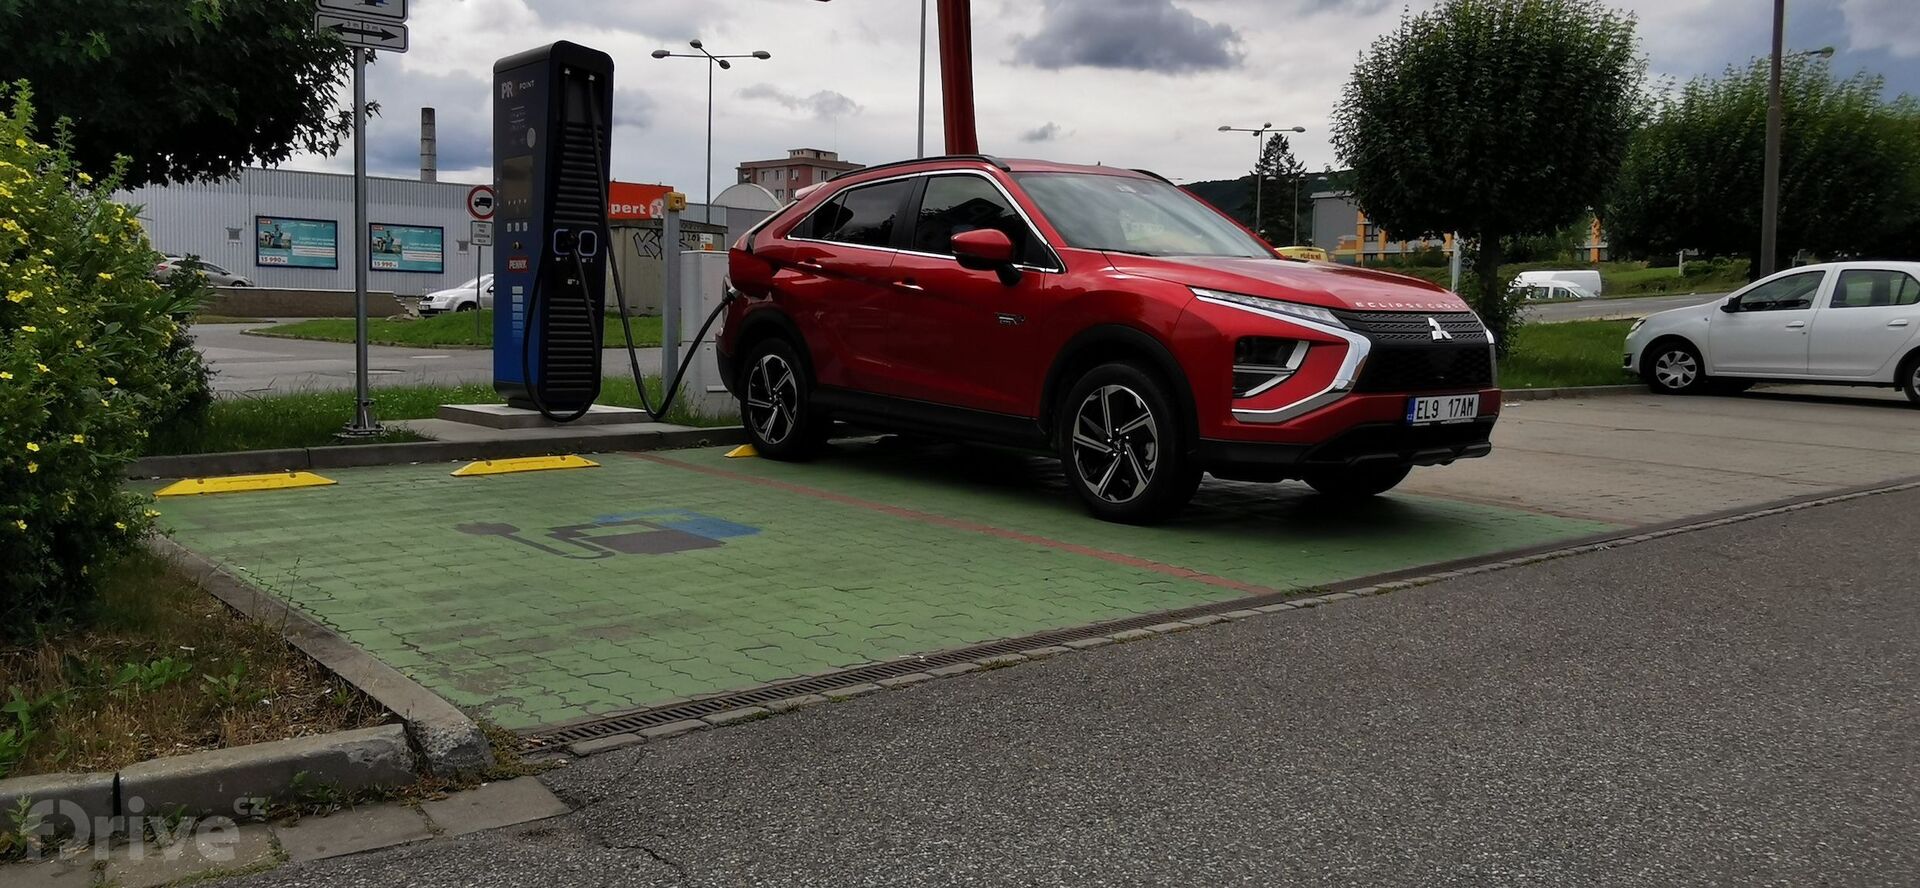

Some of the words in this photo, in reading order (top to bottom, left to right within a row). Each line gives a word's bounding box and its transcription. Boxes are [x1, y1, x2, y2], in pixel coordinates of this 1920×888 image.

[1355, 301, 1424, 309] ECLIPSE
[1416, 399, 1439, 420] EL9
[1448, 397, 1475, 418] 17AM
